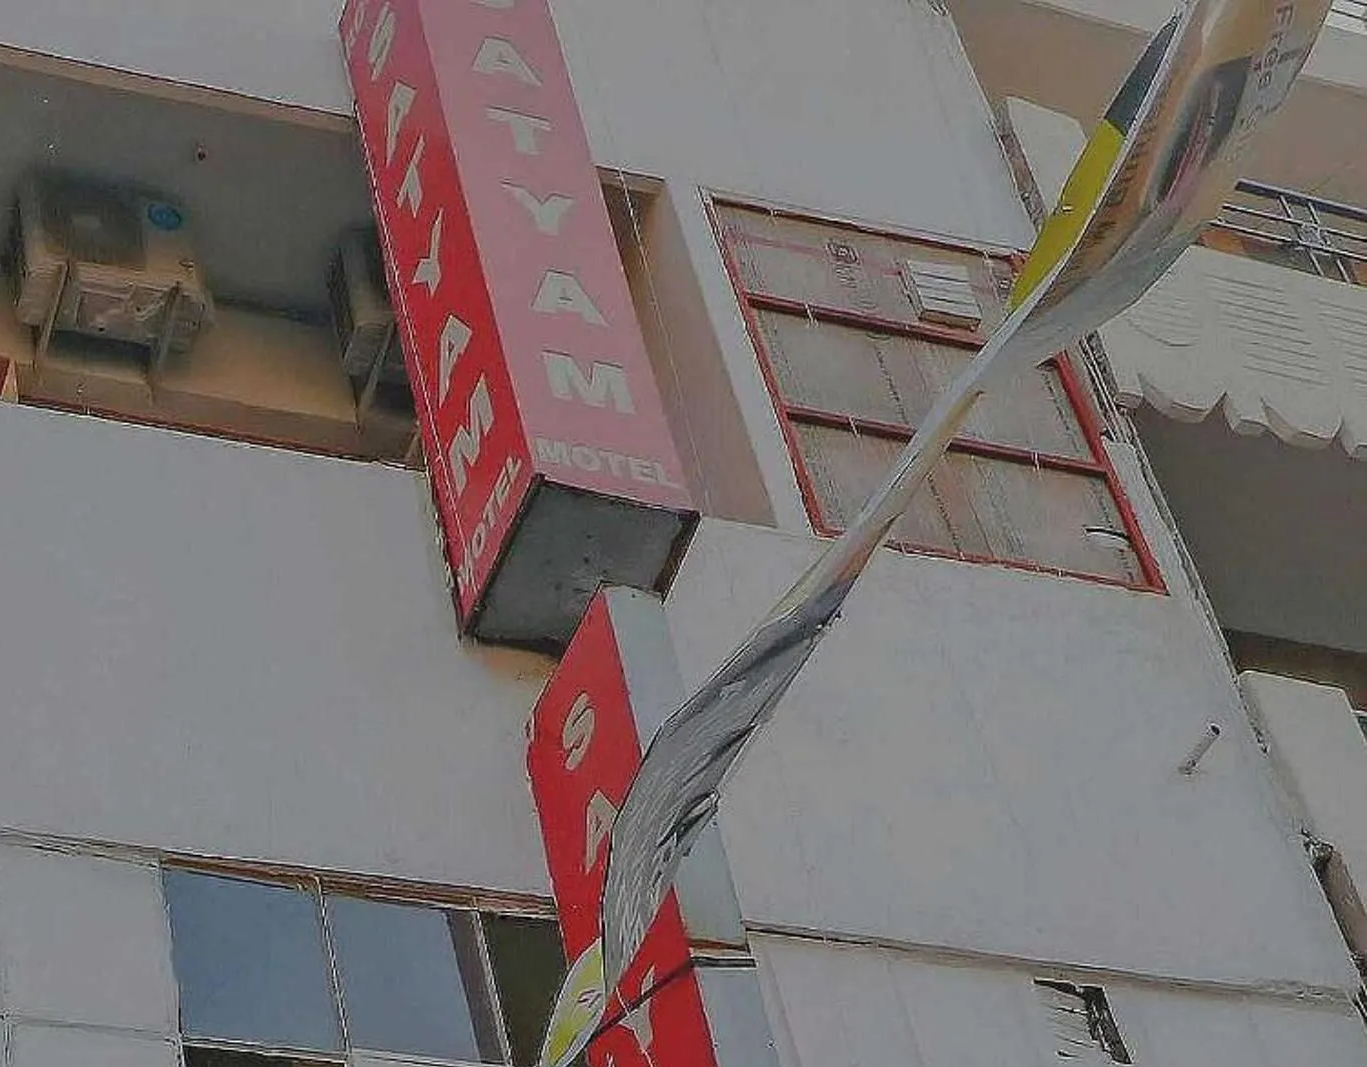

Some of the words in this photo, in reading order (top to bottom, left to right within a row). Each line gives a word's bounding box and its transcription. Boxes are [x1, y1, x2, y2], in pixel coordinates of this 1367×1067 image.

[368, 3, 495, 491] SATYAM
[470, 0, 634, 414] ATYAM
[457, 456, 522, 597] MOTEL
[536, 437, 675, 486] MOTEL
